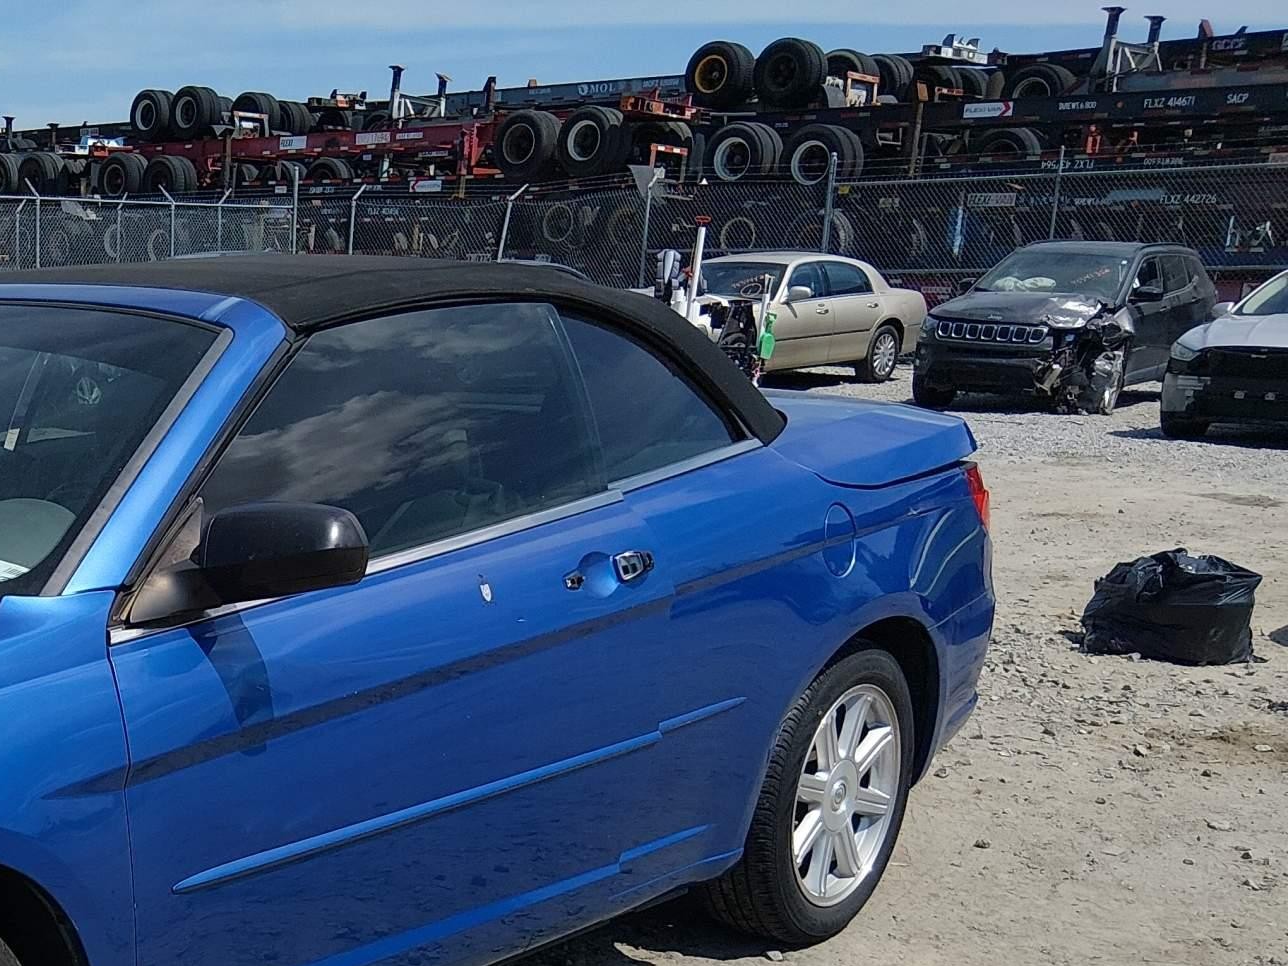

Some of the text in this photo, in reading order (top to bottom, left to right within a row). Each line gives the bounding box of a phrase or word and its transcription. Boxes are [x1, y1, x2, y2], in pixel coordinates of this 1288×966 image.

[1144, 96, 1196, 109] FLXZ 414671
[1226, 93, 1250, 104] SACP
[1074, 159, 1095, 169] FLXZ
[1159, 193, 1217, 204] FLXZ 442726
